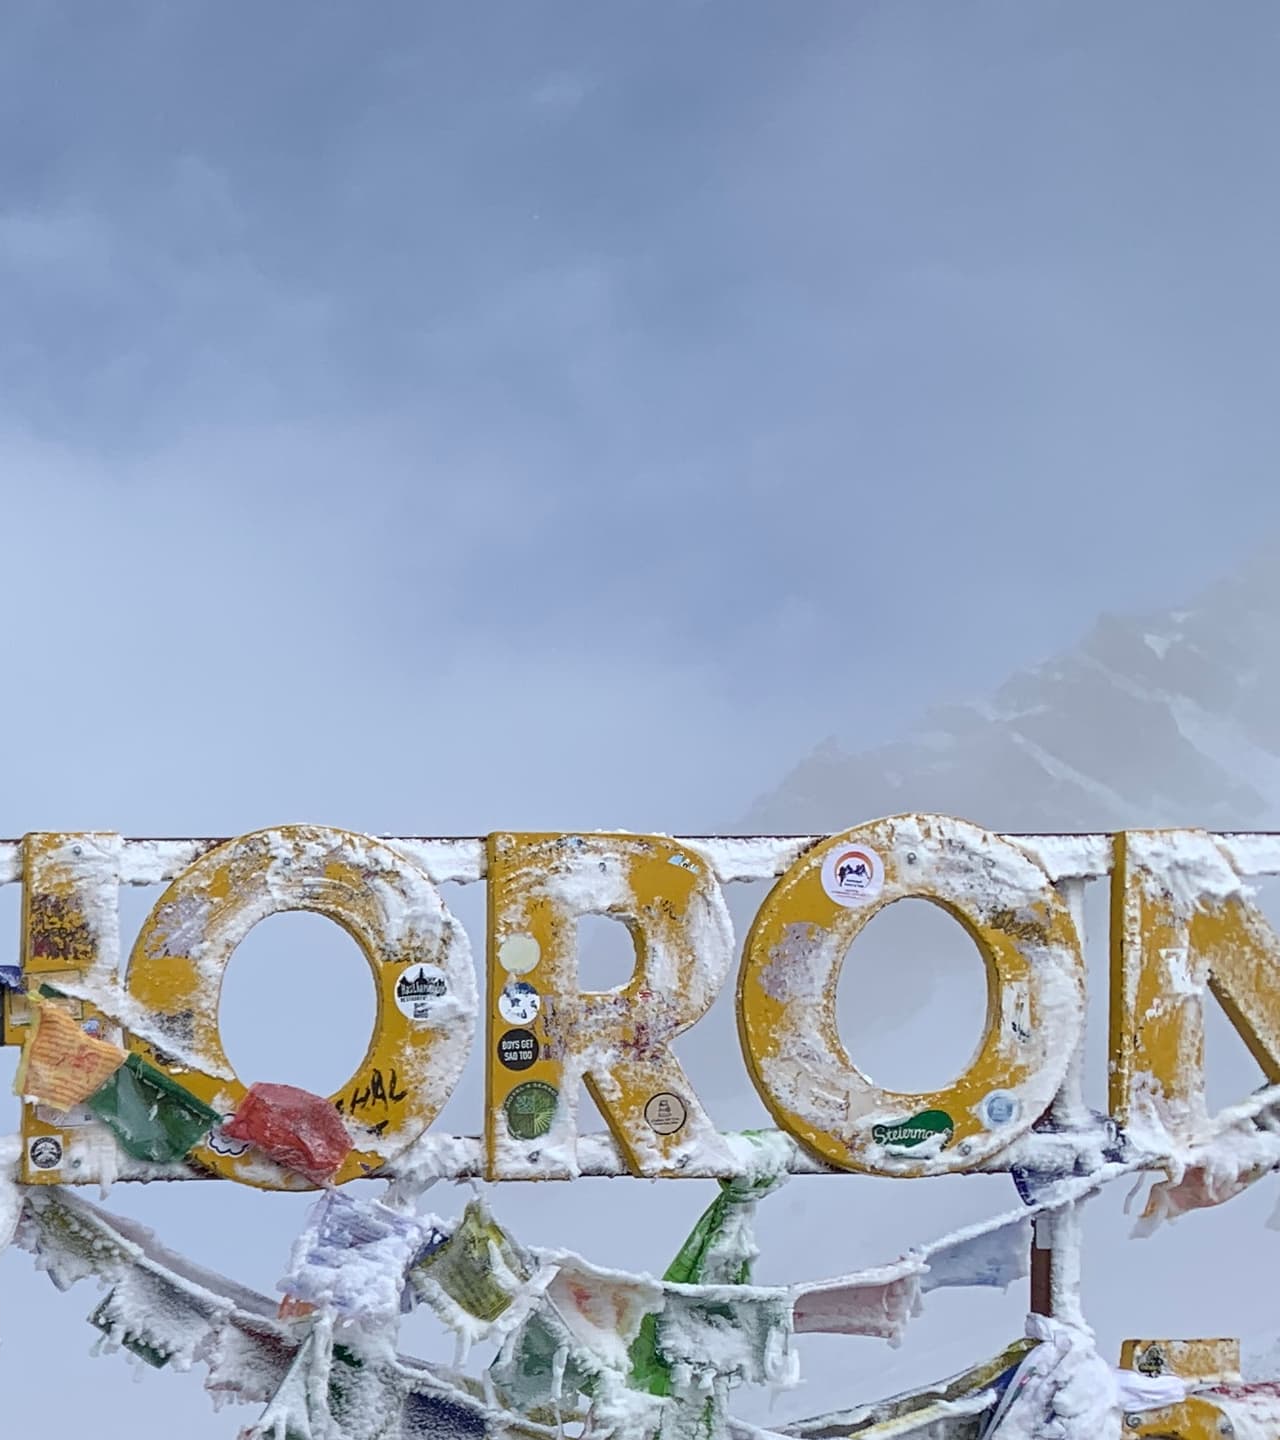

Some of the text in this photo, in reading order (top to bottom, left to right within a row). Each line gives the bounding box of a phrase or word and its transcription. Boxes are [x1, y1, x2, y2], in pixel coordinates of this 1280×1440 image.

[502, 1040, 534, 1050] BOYS GET
[504, 1051, 518, 1061] SAD
